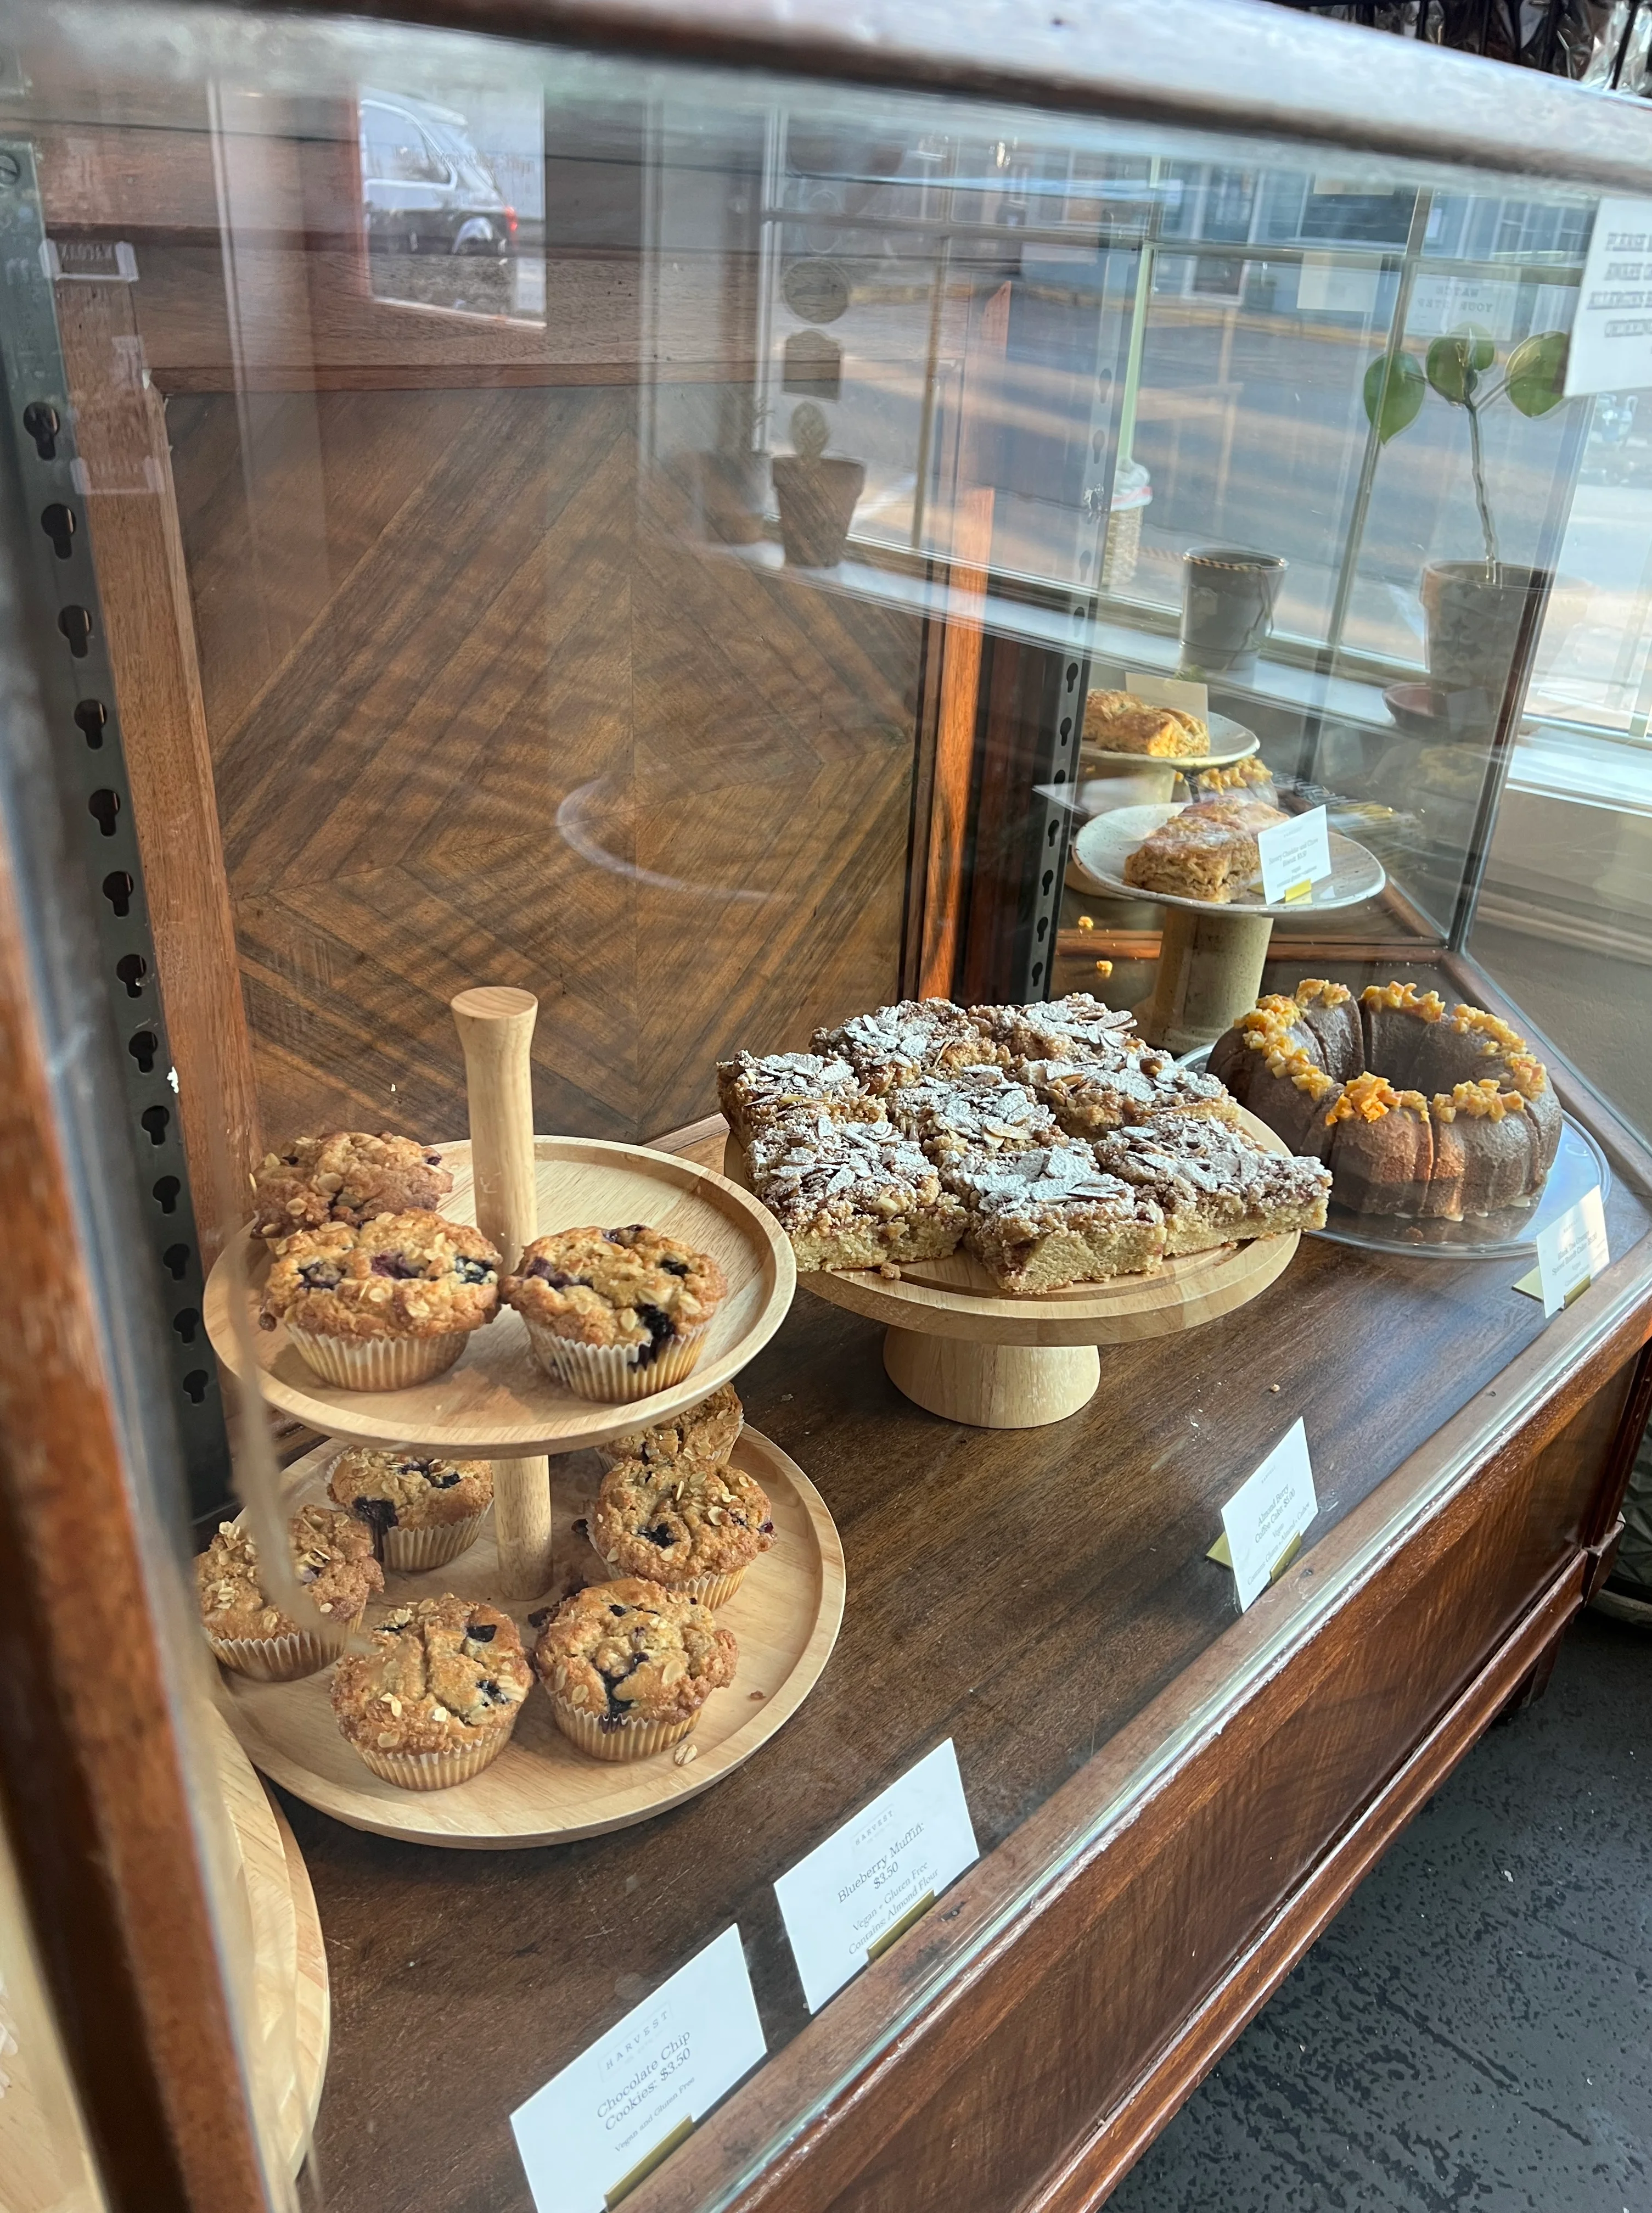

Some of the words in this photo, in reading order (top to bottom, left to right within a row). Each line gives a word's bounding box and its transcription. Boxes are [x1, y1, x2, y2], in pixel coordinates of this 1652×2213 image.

[838, 1855, 887, 1903] Blueberry
[852, 1909, 877, 1931] Vegan
[884, 1878, 911, 1904] Gluten
[911, 1862, 928, 1880] Free
[873, 1861, 898, 1889] $3.50
[887, 1885, 918, 1920] Almond
[918, 1869, 937, 1891] Flour
[606, 2010, 667, 2070] HARVEST
[597, 2060, 658, 2117] Chocolate
[661, 2032, 690, 2060] Chip
[605, 2080, 658, 2130] Cookies:
[660, 2048, 690, 2081] $3.50
[615, 2130, 638, 2152] Vegan
[639, 2114, 653, 2131] and
[654, 2093, 678, 2116] Gluten
[678, 2077, 695, 2094] Free
